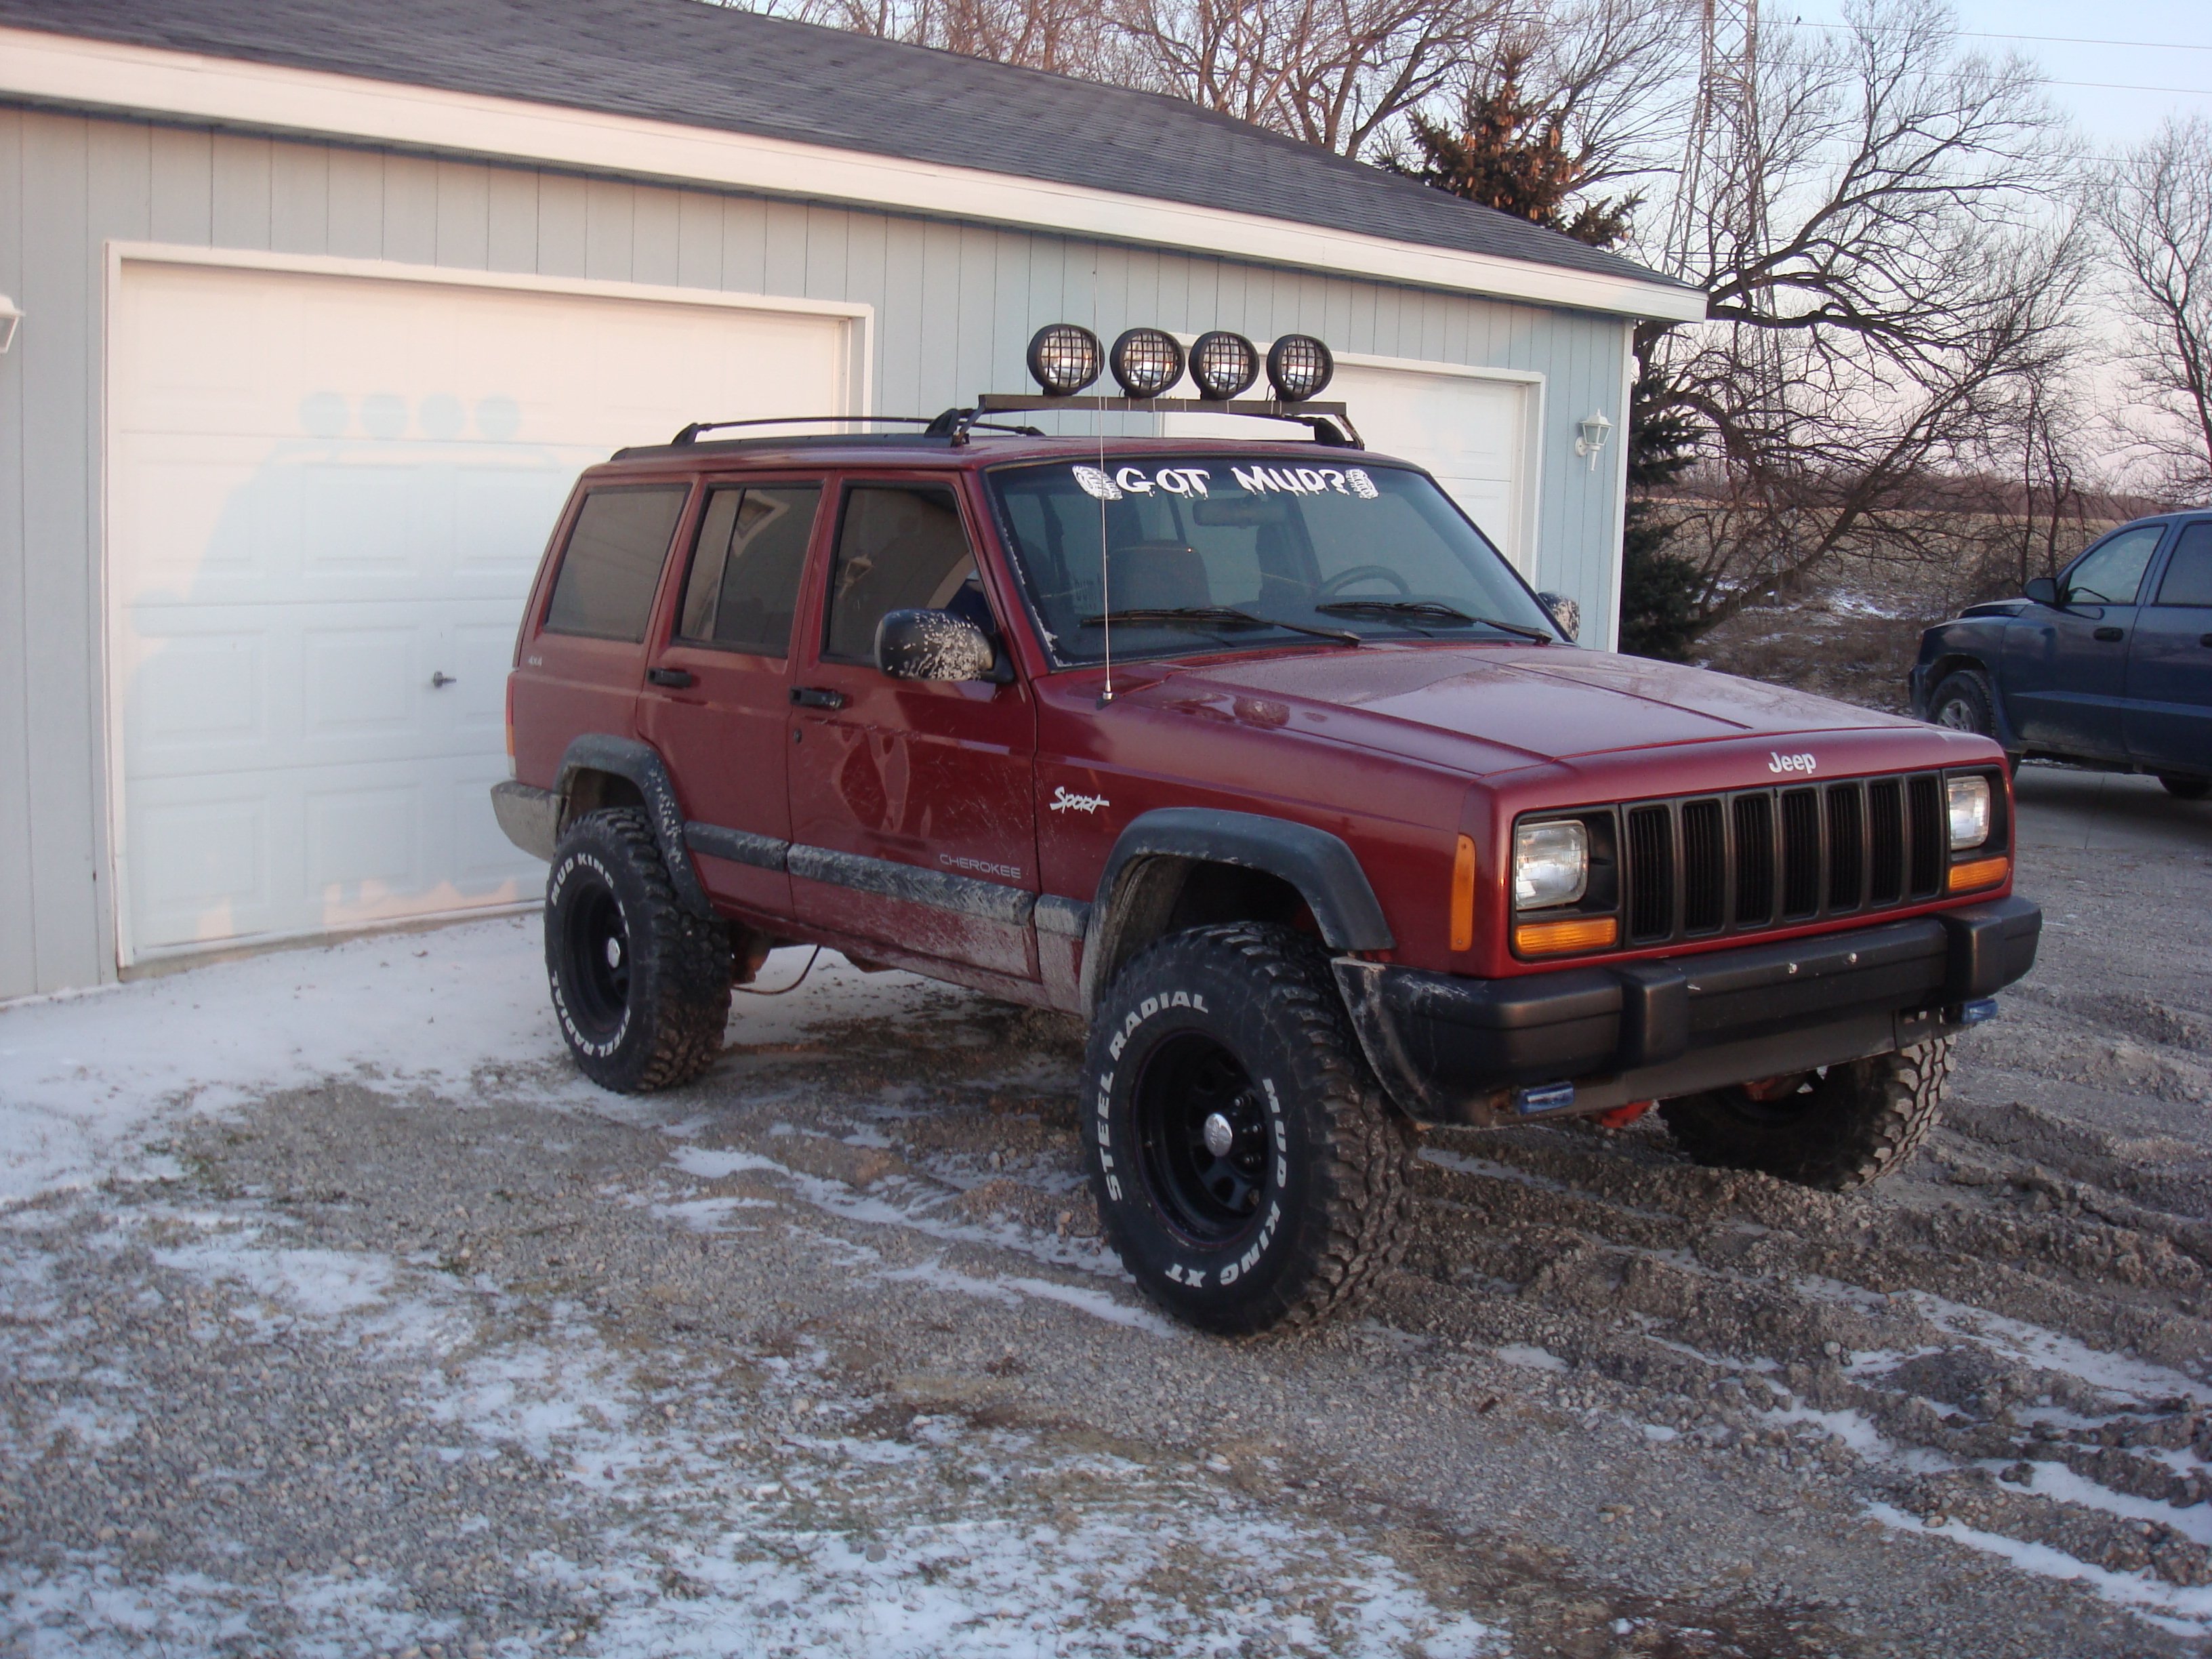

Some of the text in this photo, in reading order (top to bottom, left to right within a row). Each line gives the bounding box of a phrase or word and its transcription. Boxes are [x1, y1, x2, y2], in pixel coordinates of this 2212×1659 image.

[1115, 466, 1350, 500] GOT MUD?
[1768, 752, 1817, 775] Jeep
[550, 857, 574, 907] MUD
[577, 852, 614, 890] KING
[939, 853, 1021, 879] CHEROKEE
[551, 970, 631, 1058] STEEL RADIAL
[1097, 991, 1209, 1202] STEEL RADIAL
[1165, 1078, 1287, 1288] MUD KING XT
